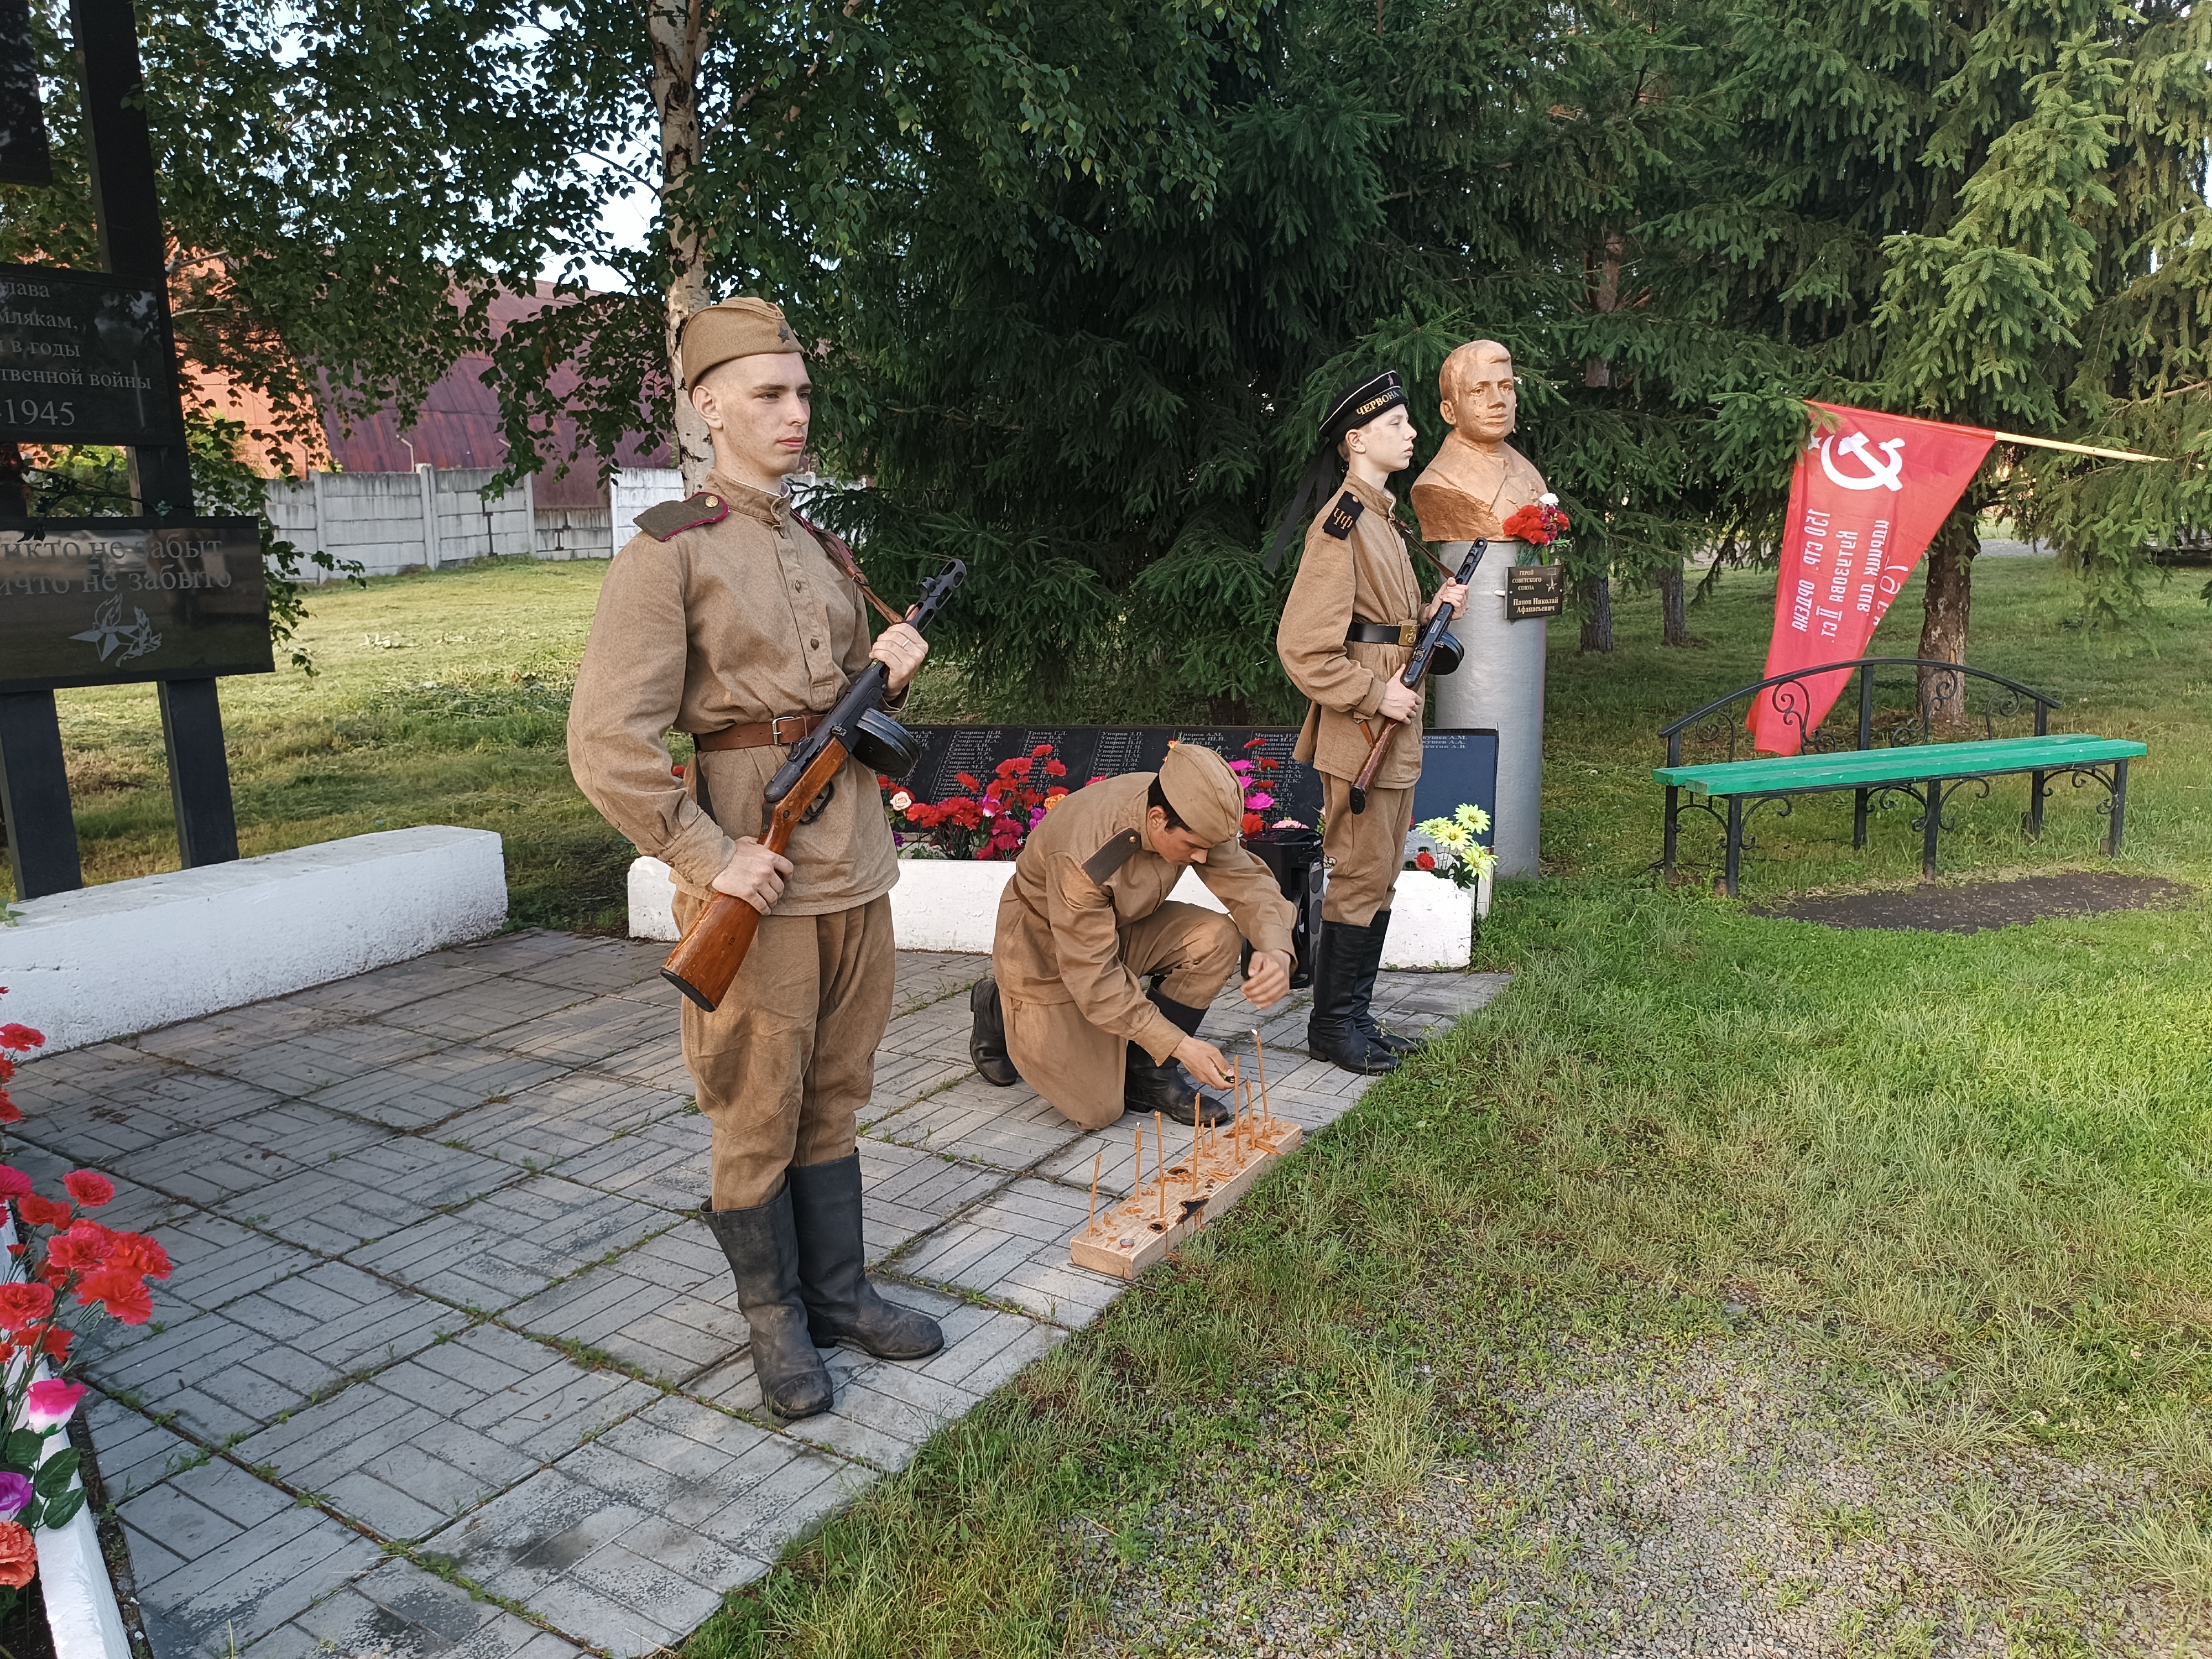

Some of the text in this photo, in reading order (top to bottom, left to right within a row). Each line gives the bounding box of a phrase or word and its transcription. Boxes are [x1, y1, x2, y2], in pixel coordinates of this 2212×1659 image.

[3, 281, 50, 298] лава
[12, 341, 23, 353] в
[30, 342, 81, 359] годы
[1, 368, 152, 389] твенной войны
[0, 399, 75, 426] 1945
[1356, 390, 1400, 416] ЧЕРВОНА
[1333, 508, 1353, 530] ЧФ
[1, 533, 223, 561] икто не забыт
[0, 564, 232, 596] ичто не забыто
[1516, 606, 1555, 614] Афанасьевич
[1533, 597, 1559, 605] Николай
